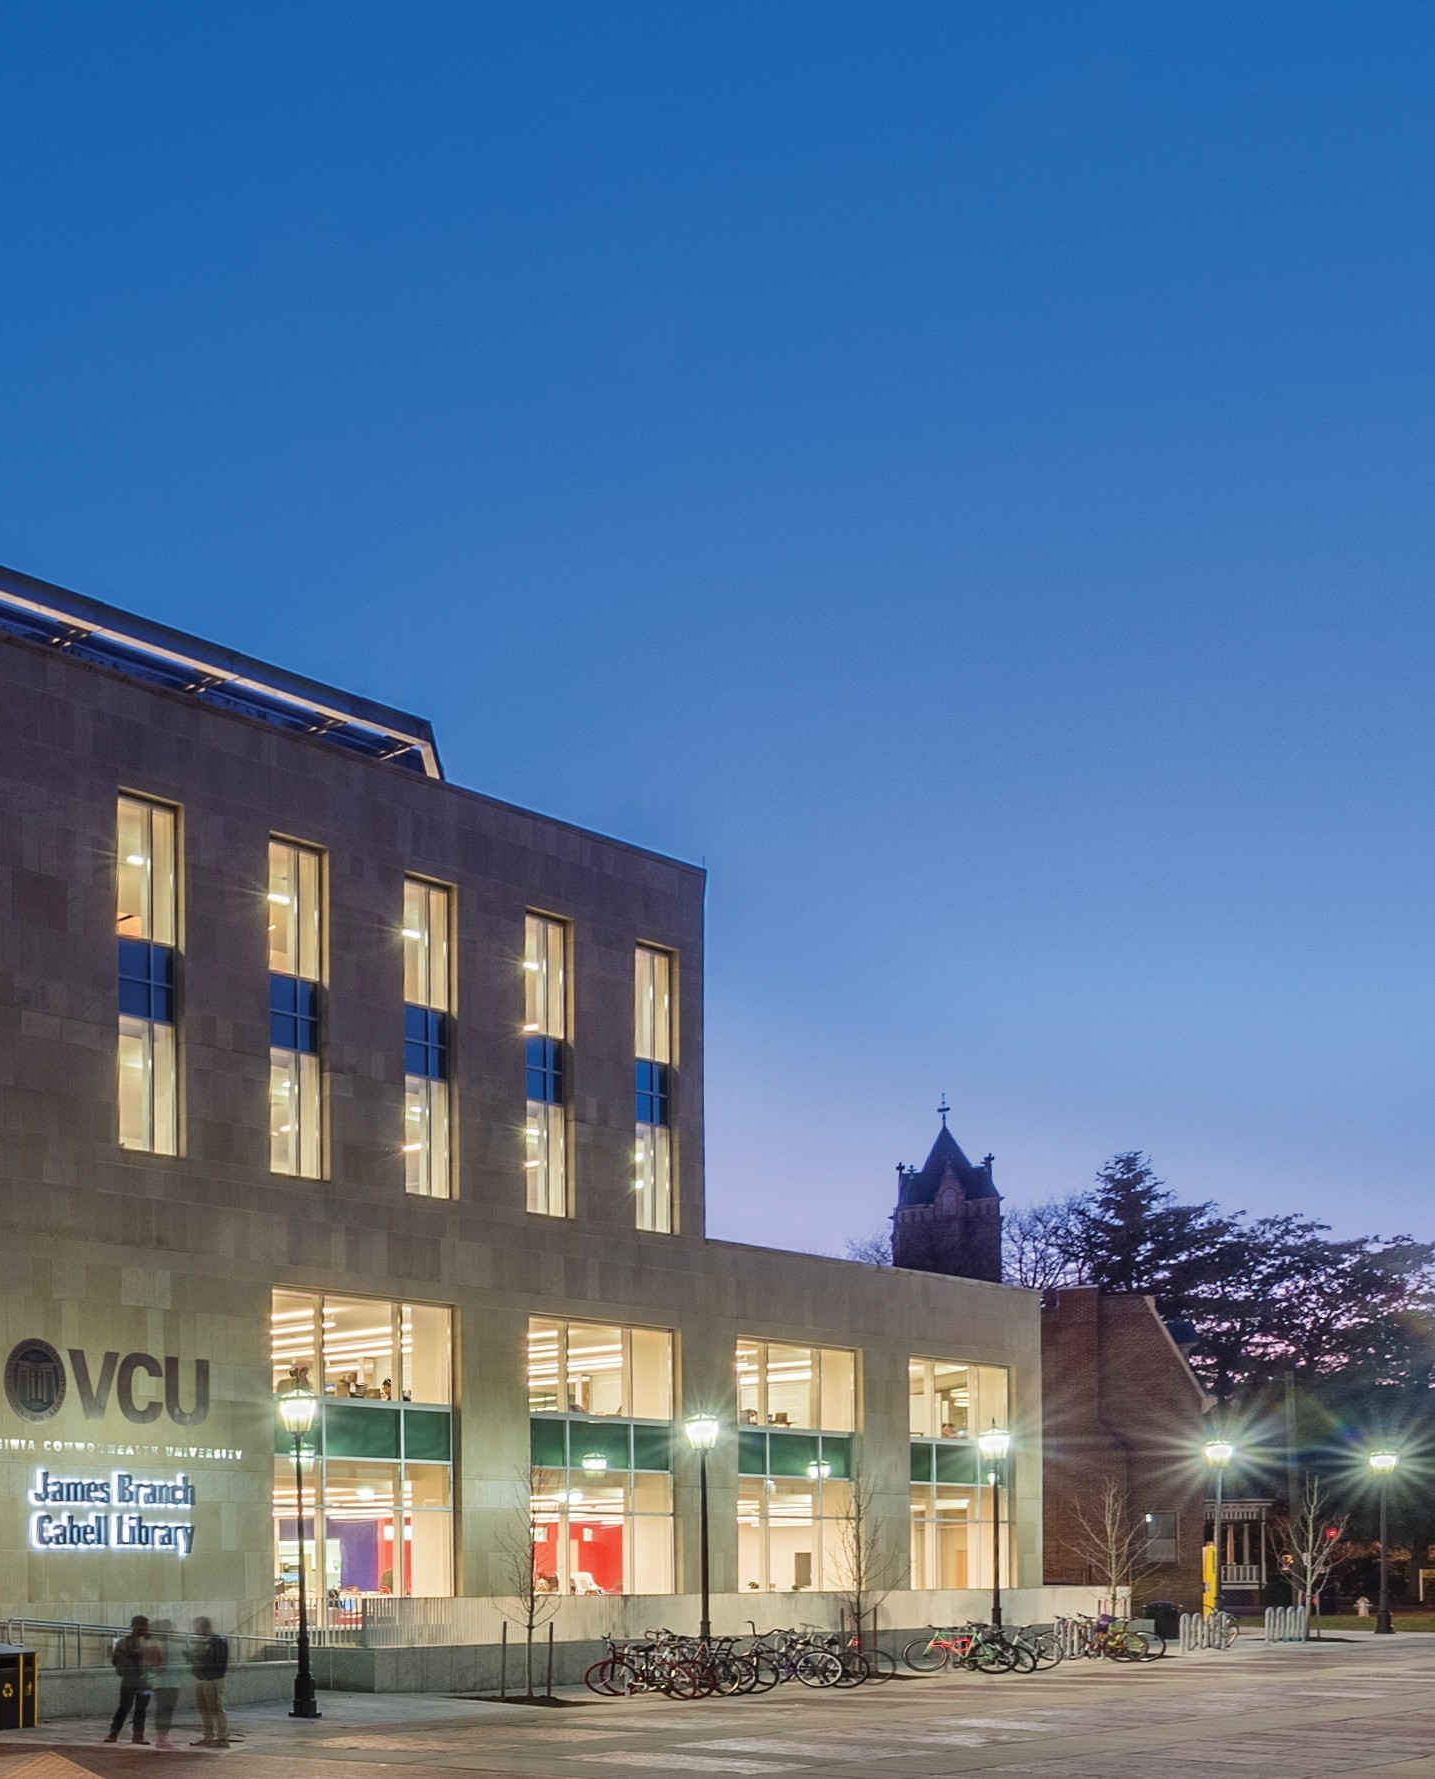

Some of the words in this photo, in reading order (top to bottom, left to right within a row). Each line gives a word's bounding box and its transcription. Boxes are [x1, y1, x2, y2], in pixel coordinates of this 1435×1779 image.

[68, 1349, 210, 1427] VCU
[165, 1446, 243, 1460] UNIVERSITY
[32, 1471, 111, 1504] James
[116, 1473, 196, 1506] Branch
[36, 1514, 109, 1546] Cabell
[116, 1514, 195, 1554] Library
